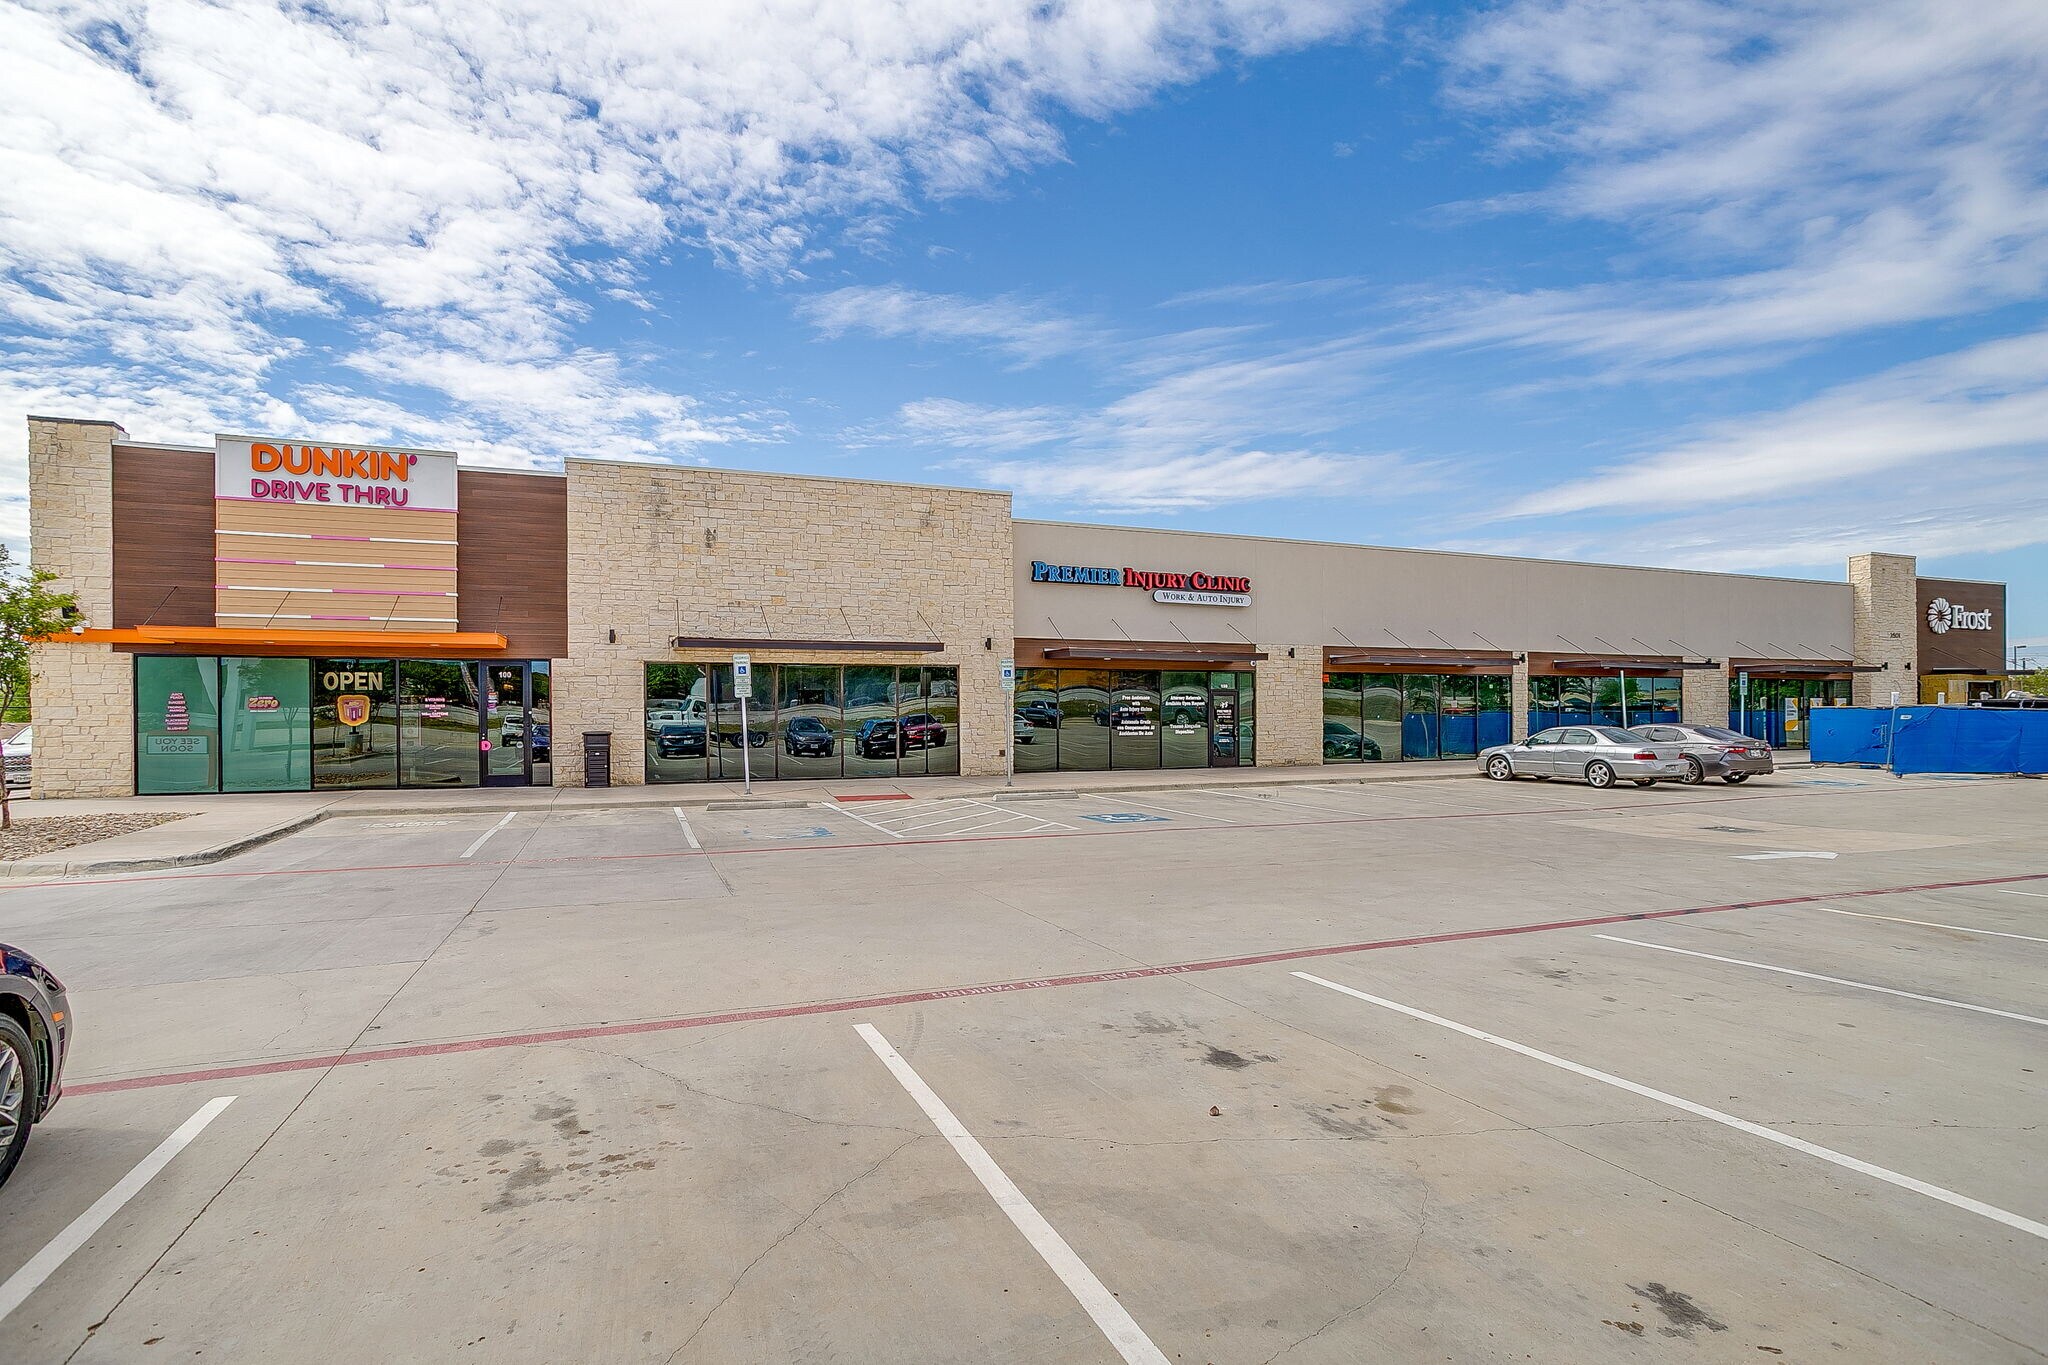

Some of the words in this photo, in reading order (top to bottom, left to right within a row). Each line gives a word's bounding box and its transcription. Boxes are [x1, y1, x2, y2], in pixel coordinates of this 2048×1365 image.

[251, 443, 417, 482] DUNKIN'
[251, 478, 330, 502] DRIVE
[337, 484, 409, 506] THRU
[1032, 561, 1121, 586] PREMIER
[1123, 567, 1187, 590] INJURY
[1190, 571, 1251, 592] CLINIC
[1162, 592, 1186, 601] WORK
[1187, 593, 1195, 601] &
[1196, 594, 1218, 603] AUTO
[1220, 596, 1245, 605] INJURY
[1950, 604, 1992, 631] Frost
[323, 671, 383, 691] OPEN
[498, 671, 512, 679] 100
[249, 697, 279, 708] Zero
